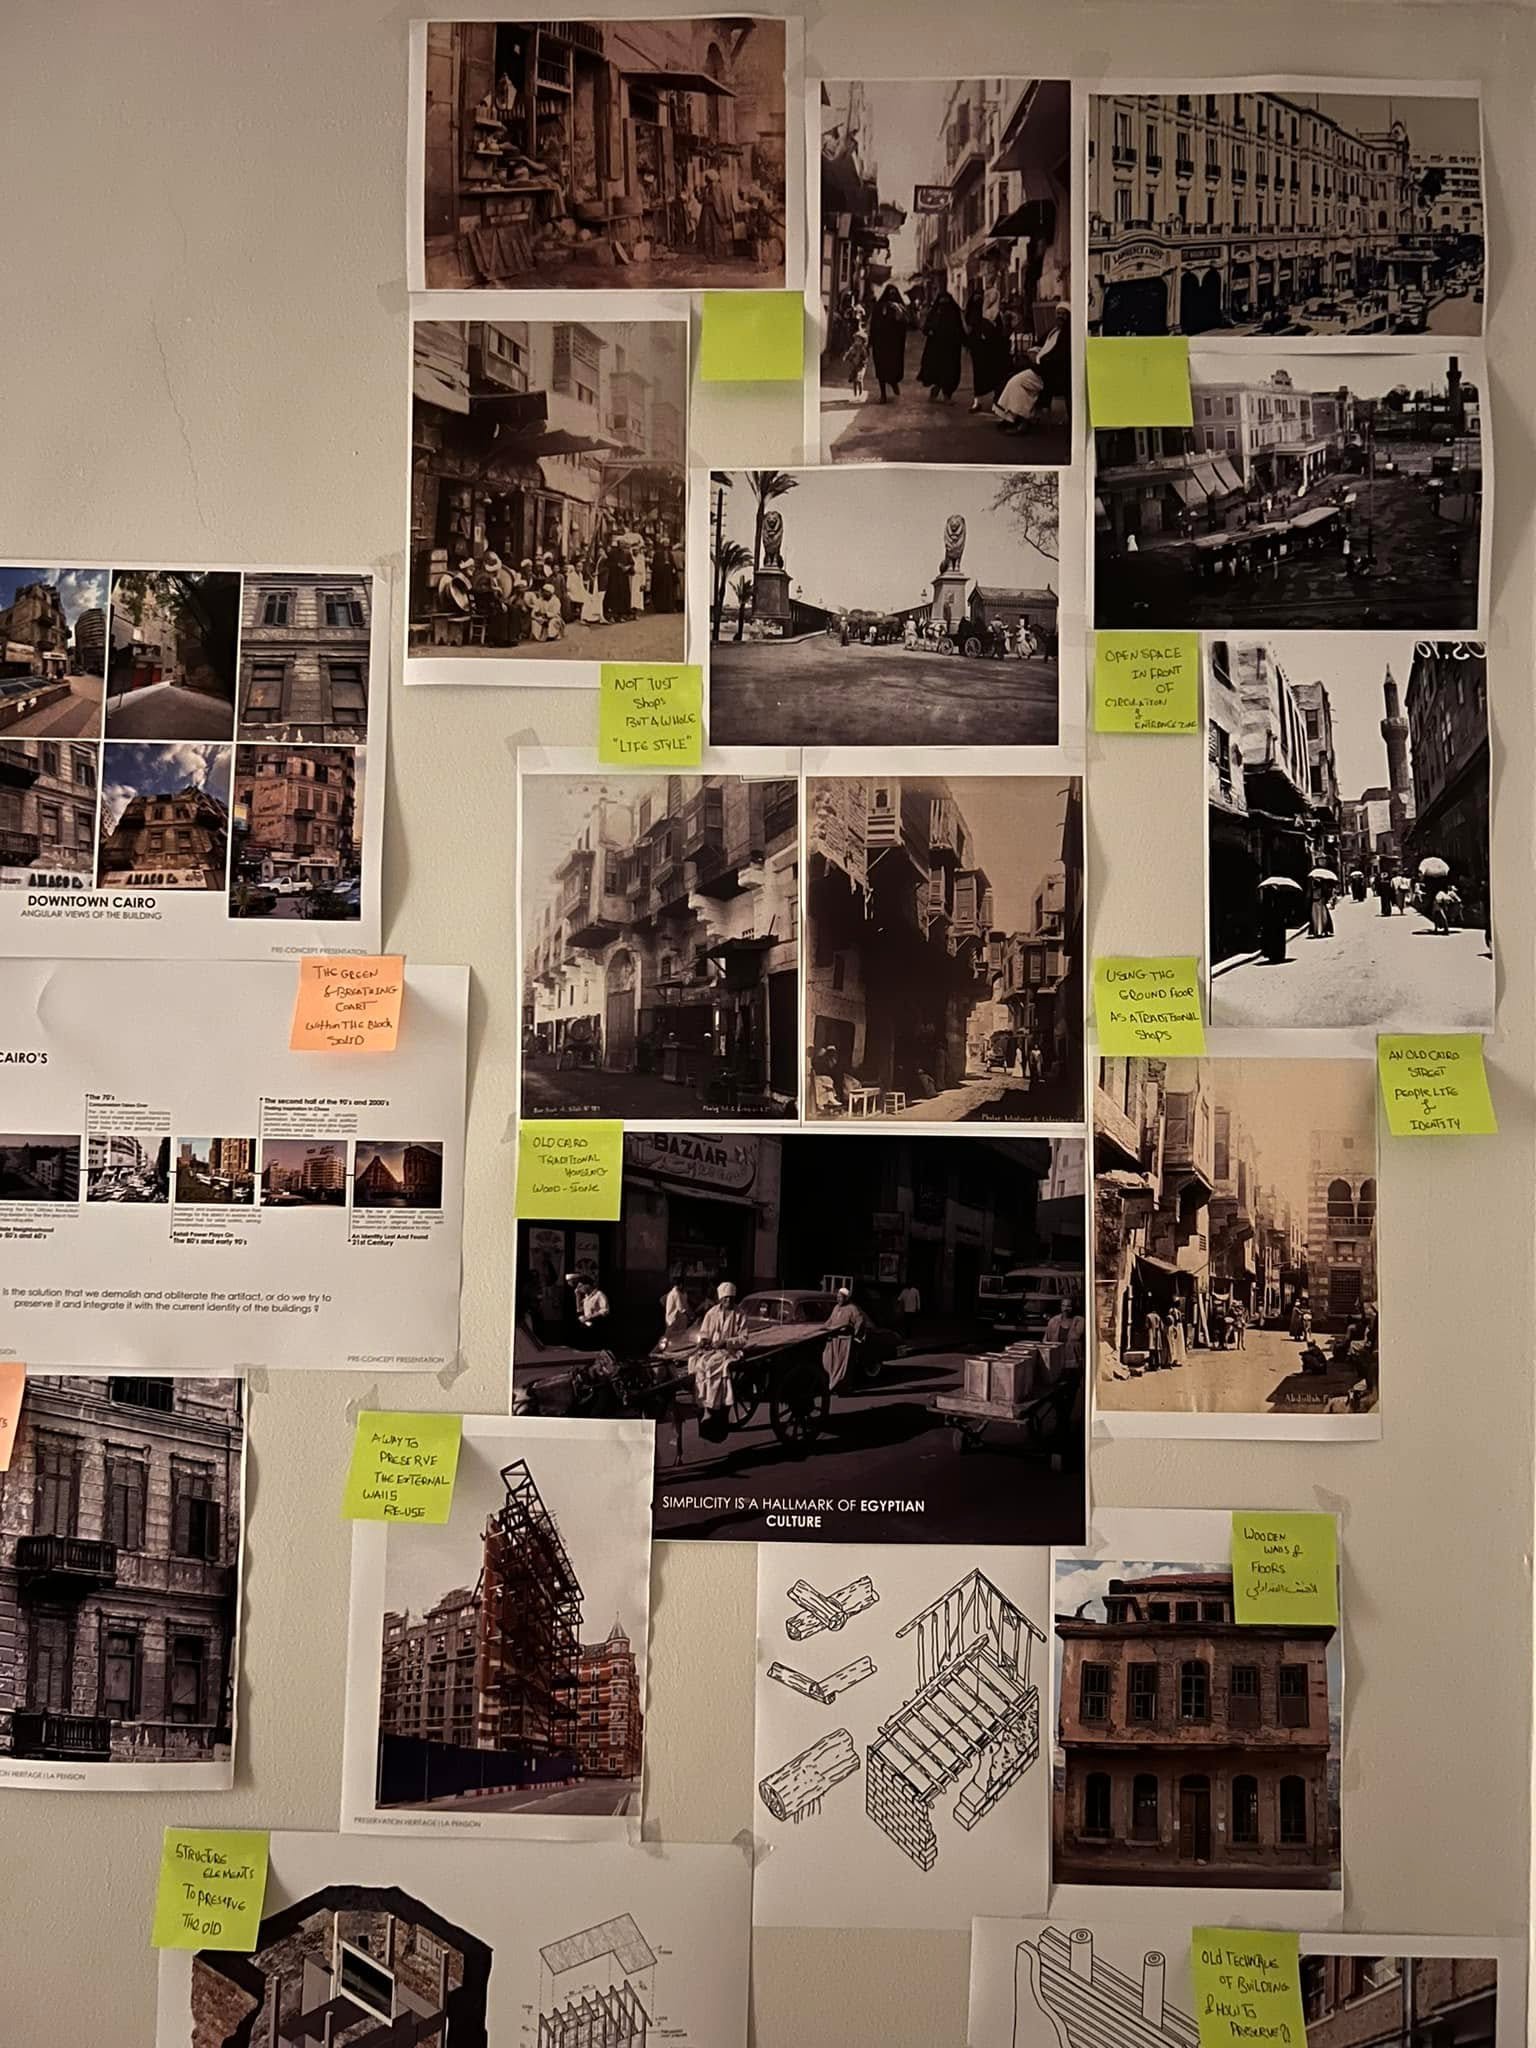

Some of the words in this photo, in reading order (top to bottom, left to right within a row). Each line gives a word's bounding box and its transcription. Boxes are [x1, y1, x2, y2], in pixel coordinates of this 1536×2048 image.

[1105, 649, 1139, 663] OPEN
[1140, 647, 1183, 661] SPACE
[1131, 670, 1147, 679] IN
[1150, 665, 1183, 679] FRONT
[615, 677, 644, 691] NOT
[647, 676, 679, 691] JUST
[1156, 682, 1175, 693] OF
[626, 716, 649, 728] BUT
[650, 716, 659, 727] A
[28, 895, 109, 907] DOWNTOWN
[113, 897, 156, 909] CAIRO
[21, 910, 63, 918] ANGULAR
[65, 910, 90, 918] VIEWS
[92, 910, 104, 919] OF
[106, 911, 121, 919] THE
[123, 911, 163, 920] BUILDING
[312, 966, 338, 979] THE
[340, 969, 379, 980] GREEN
[1106, 969, 1147, 982] USING
[1149, 970, 1175, 981] THE
[1119, 988, 1167, 1001] GROUND
[1110, 1011, 1127, 1022] AS
[1130, 1013, 1138, 1023] A
[1135, 1010, 1200, 1023] TRADITIONAL
[1389, 1050, 1403, 1061] AN
[1405, 1049, 1427, 1060] OLD
[1428, 1050, 1461, 1061] CAIRO
[1408, 1066, 1447, 1078] STREET
[1409, 1118, 1461, 1131] IDENTITY
[533, 1137, 555, 1148] OLD
[557, 1137, 589, 1148] CAIRO
[654, 1133, 728, 1168] BAZAAR
[538, 1154, 601, 1166] TRADITIONAL
[532, 1184, 561, 1193] WOOD
[11, 1288, 26, 1296] the
[28, 1288, 62, 1297] solution
[65, 1289, 83, 1297] that
[101, 1289, 141, 1299] demolish
[144, 1290, 162, 1299] and
[164, 1291, 208, 1301] obliterate
[210, 1292, 225, 1300] the
[277, 1293, 290, 1301] do
[292, 1294, 306, 1302] we
[308, 1293, 319, 1303] try
[322, 1294, 332, 1302] to
[14, 1300, 53, 1309] preserve
[62, 1300, 81, 1308] and
[83, 1300, 124, 1310] integrate
[126, 1301, 132, 1309] it
[134, 1302, 153, 1310] with
[155, 1302, 170, 1310] the
[172, 1303, 205, 1311] current
[206, 1303, 240, 1313] identity
[242, 1304, 252, 1312] of
[254, 1304, 269, 1312] the
[272, 1304, 312, 1314] buildings
[347, 1355, 394, 1363] PRE-CONCEPT
[396, 1356, 444, 1364] PRESENTATION
[372, 1433, 381, 1443] A
[382, 1434, 403, 1446] WAY
[405, 1437, 419, 1448] TO
[380, 1450, 438, 1466] PRESERVE
[374, 1471, 394, 1483] THE
[396, 1474, 450, 1486] EXTERNAL
[662, 1496, 731, 1510] SIMPLICITY
[734, 1497, 745, 1510] IS
[749, 1498, 759, 1510] A
[762, 1498, 834, 1512] HALLMARK
[837, 1500, 857, 1512] OF
[860, 1500, 925, 1513] EGYPTIAN
[766, 1515, 822, 1528] CULTURE
[1244, 1527, 1286, 1542] WOODEN
[11, 1770, 41, 1779] HERITAGE
[175, 1843, 227, 1865] STRUCTURE
[203, 1866, 255, 1880] ELEMENTS
